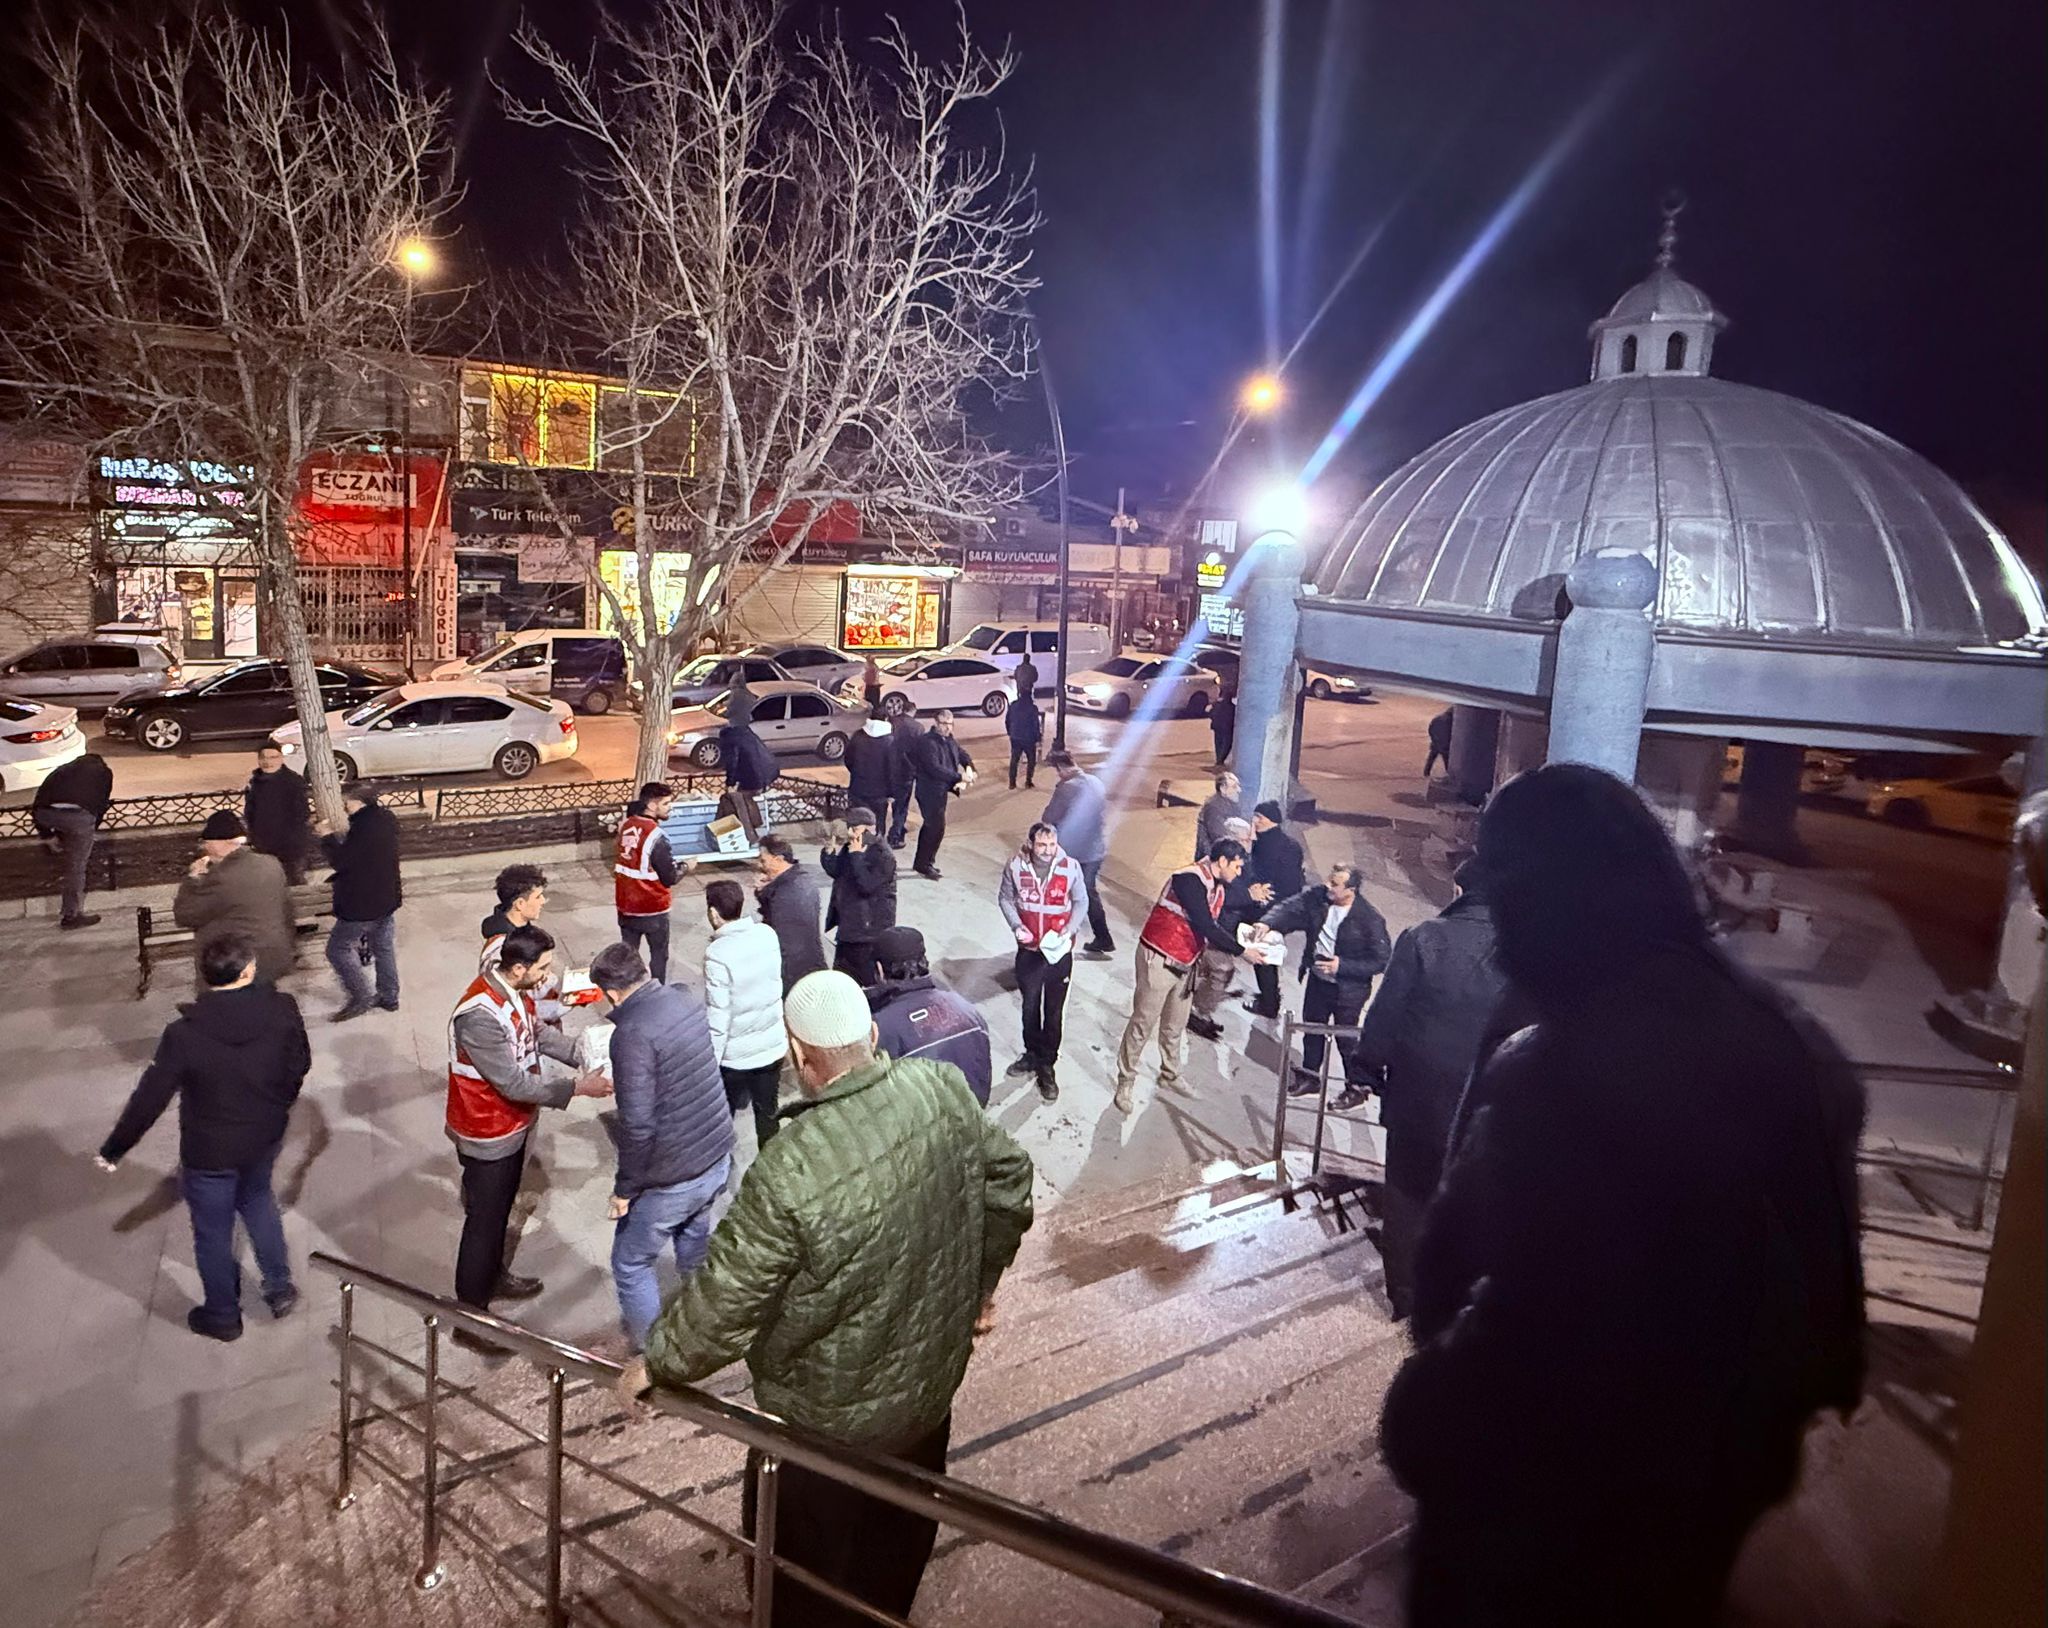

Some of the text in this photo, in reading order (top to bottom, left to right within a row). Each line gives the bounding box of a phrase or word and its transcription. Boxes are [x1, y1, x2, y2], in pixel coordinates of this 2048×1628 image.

[491, 507, 521, 521] Türk
[968, 550, 1058, 563] SAFA KUYUMCULUK
